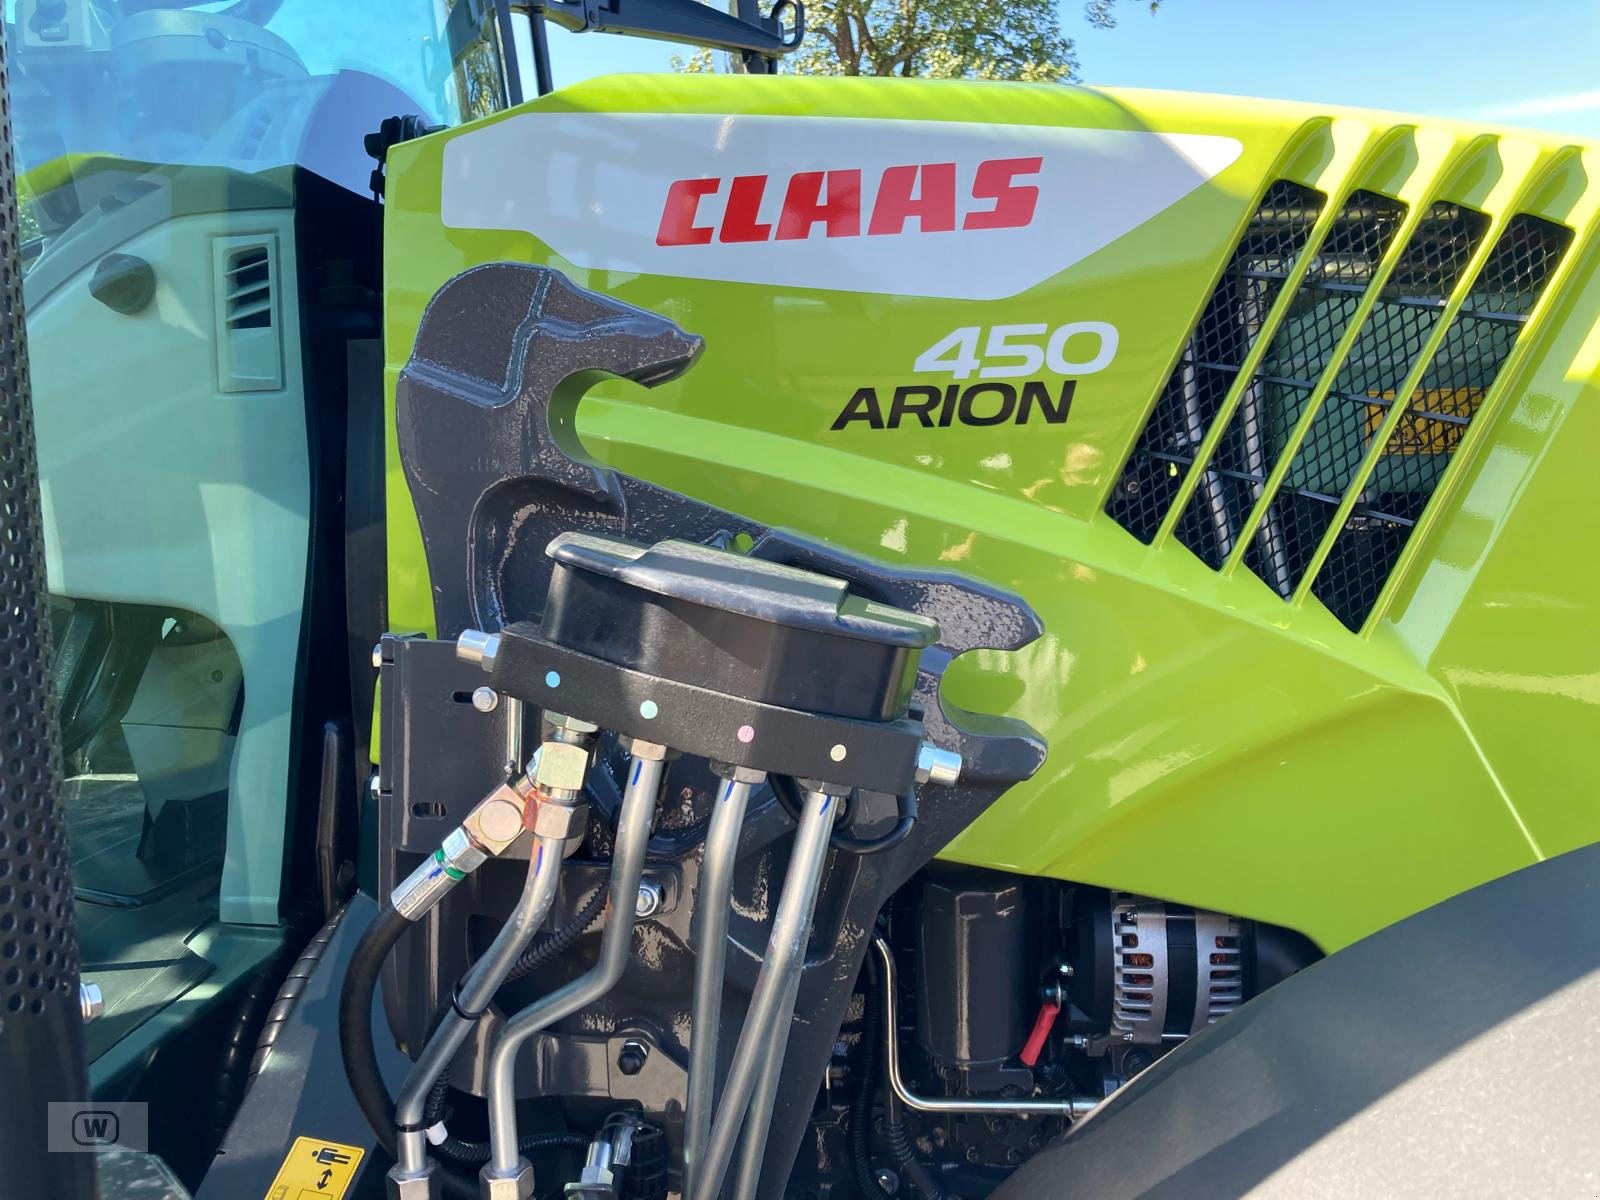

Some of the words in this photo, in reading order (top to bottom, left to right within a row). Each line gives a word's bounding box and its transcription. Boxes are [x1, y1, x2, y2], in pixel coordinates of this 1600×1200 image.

[656, 157, 1043, 247] CLAAS
[913, 320, 1120, 381] 450
[830, 379, 1078, 431] ARION
